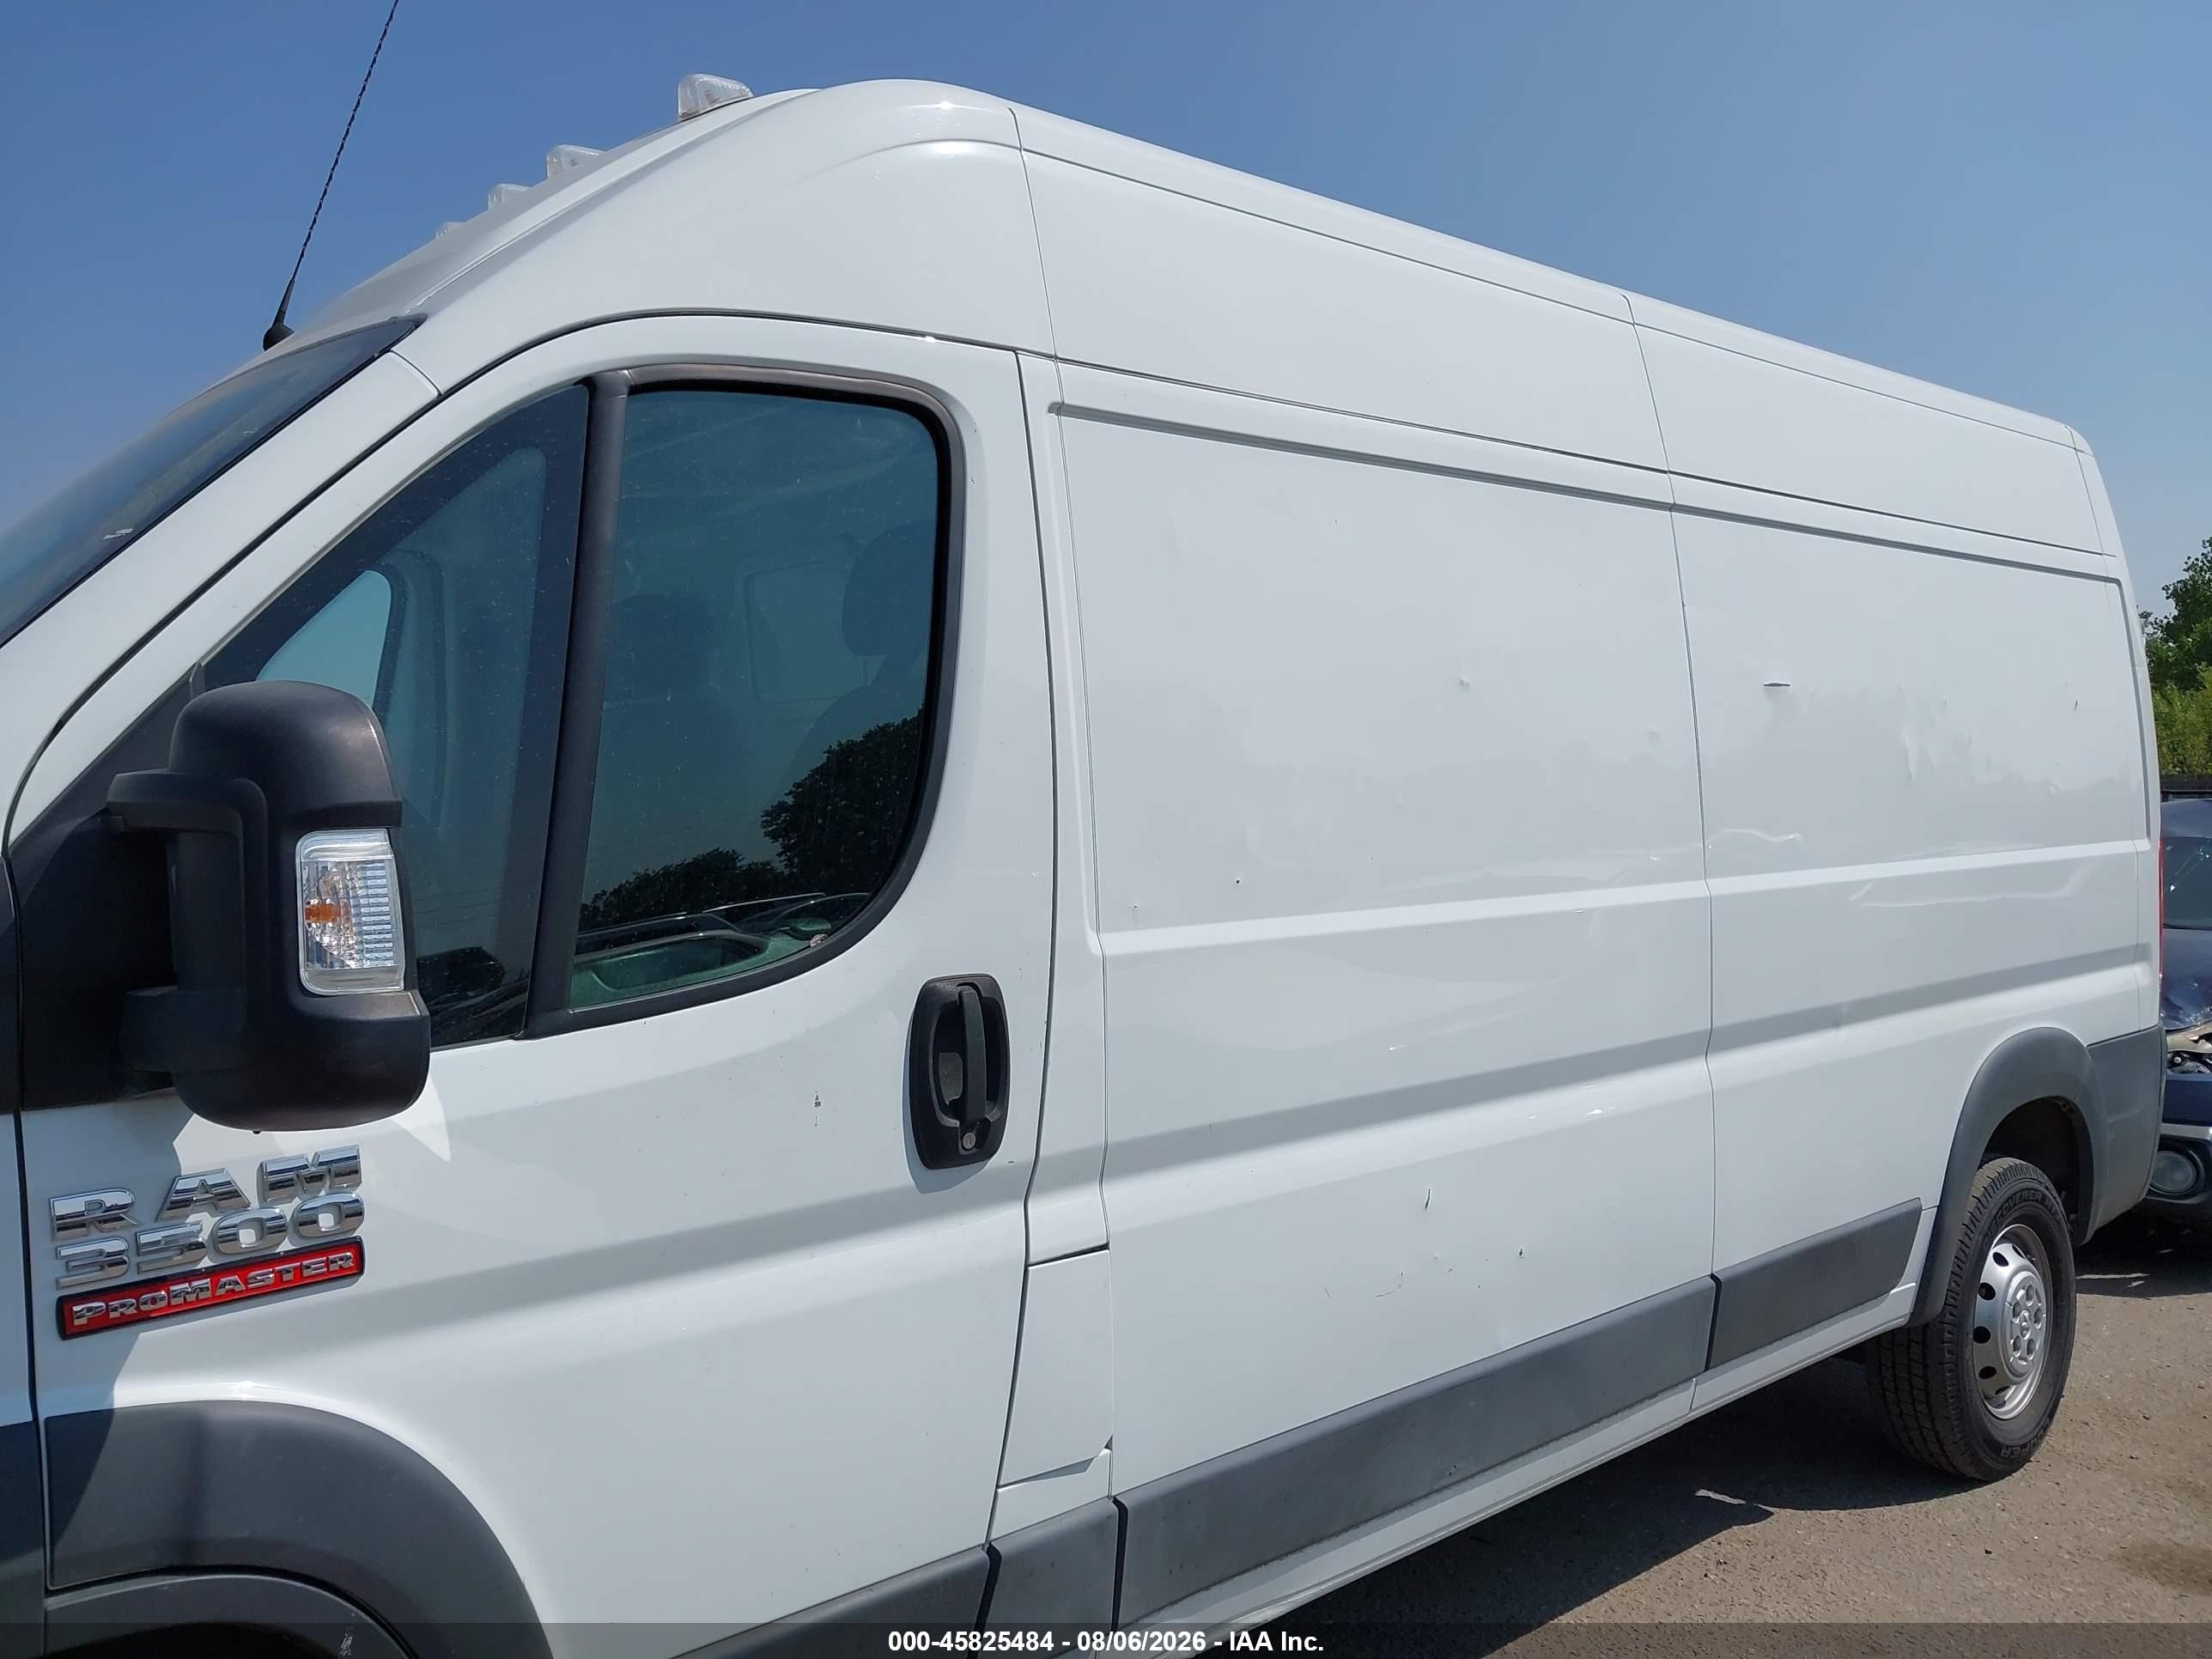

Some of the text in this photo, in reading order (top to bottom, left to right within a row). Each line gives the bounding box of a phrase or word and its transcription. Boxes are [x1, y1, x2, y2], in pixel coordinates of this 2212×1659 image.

[51, 1145, 362, 1238] RAM
[56, 1193, 365, 1287] 3500
[72, 1252, 356, 1325] PROMASTER
